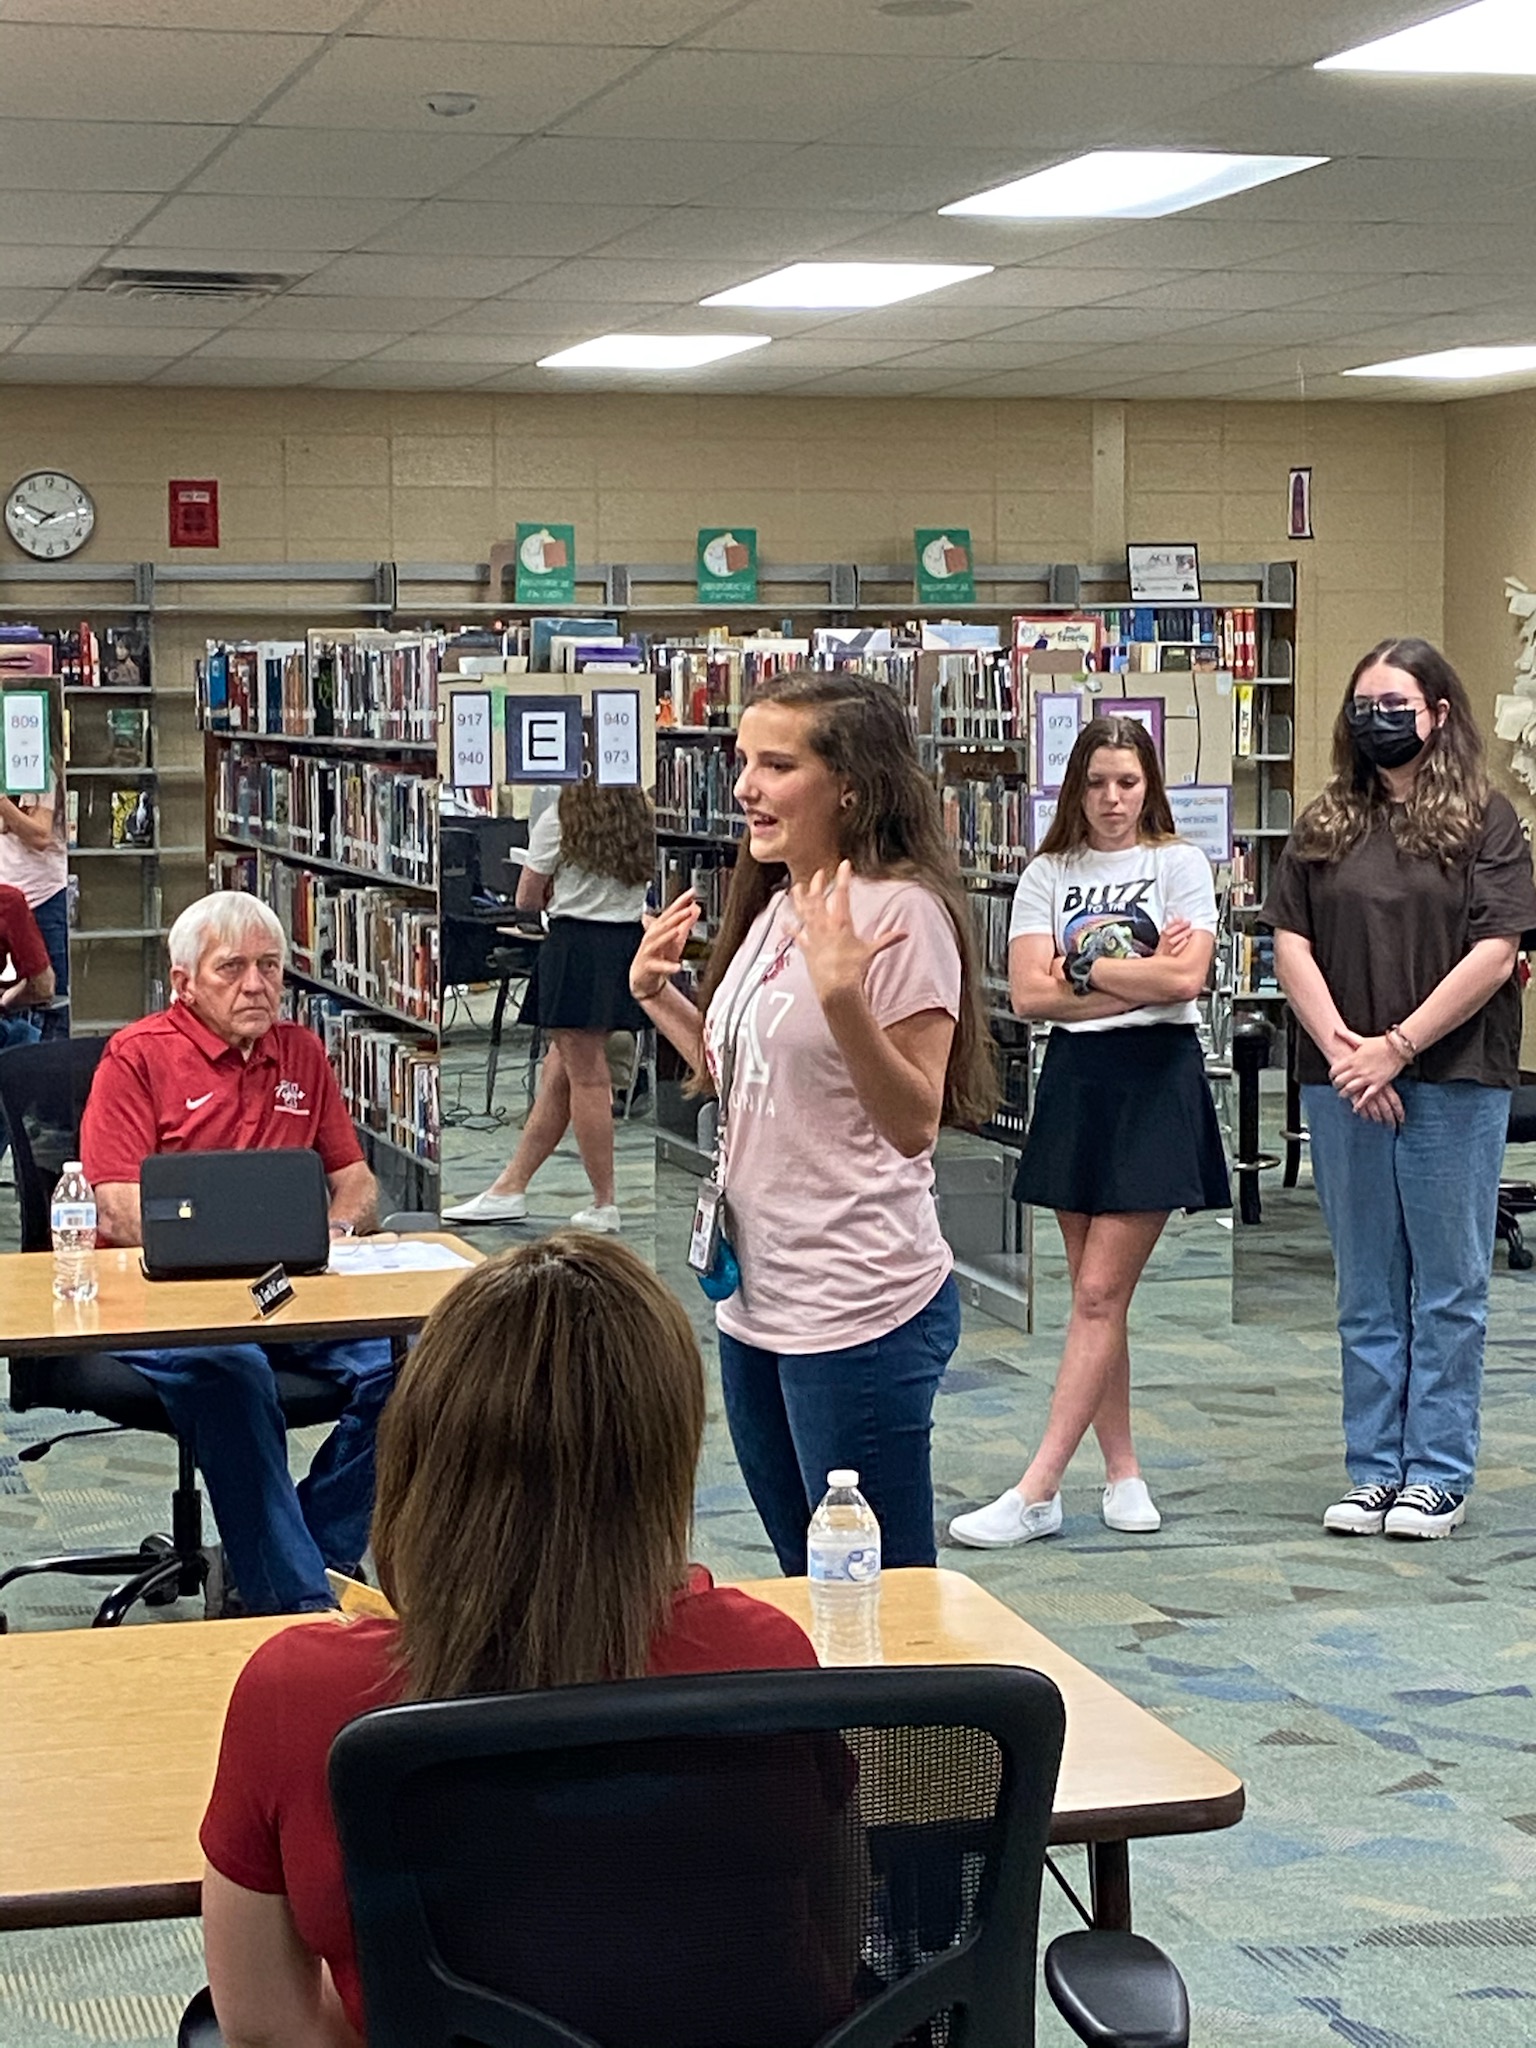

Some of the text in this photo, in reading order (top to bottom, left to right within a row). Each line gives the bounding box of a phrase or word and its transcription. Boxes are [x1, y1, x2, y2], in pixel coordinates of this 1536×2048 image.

[11, 715, 39, 729] 809
[457, 713, 483, 726] 917
[603, 712, 630, 726] 940
[1048, 716, 1073, 729] 973
[528, 719, 559, 761] E
[11, 754, 39, 769] 917
[458, 751, 484, 766] 940
[604, 750, 630, 764] 973
[1062, 878, 1156, 913] BUZZ
